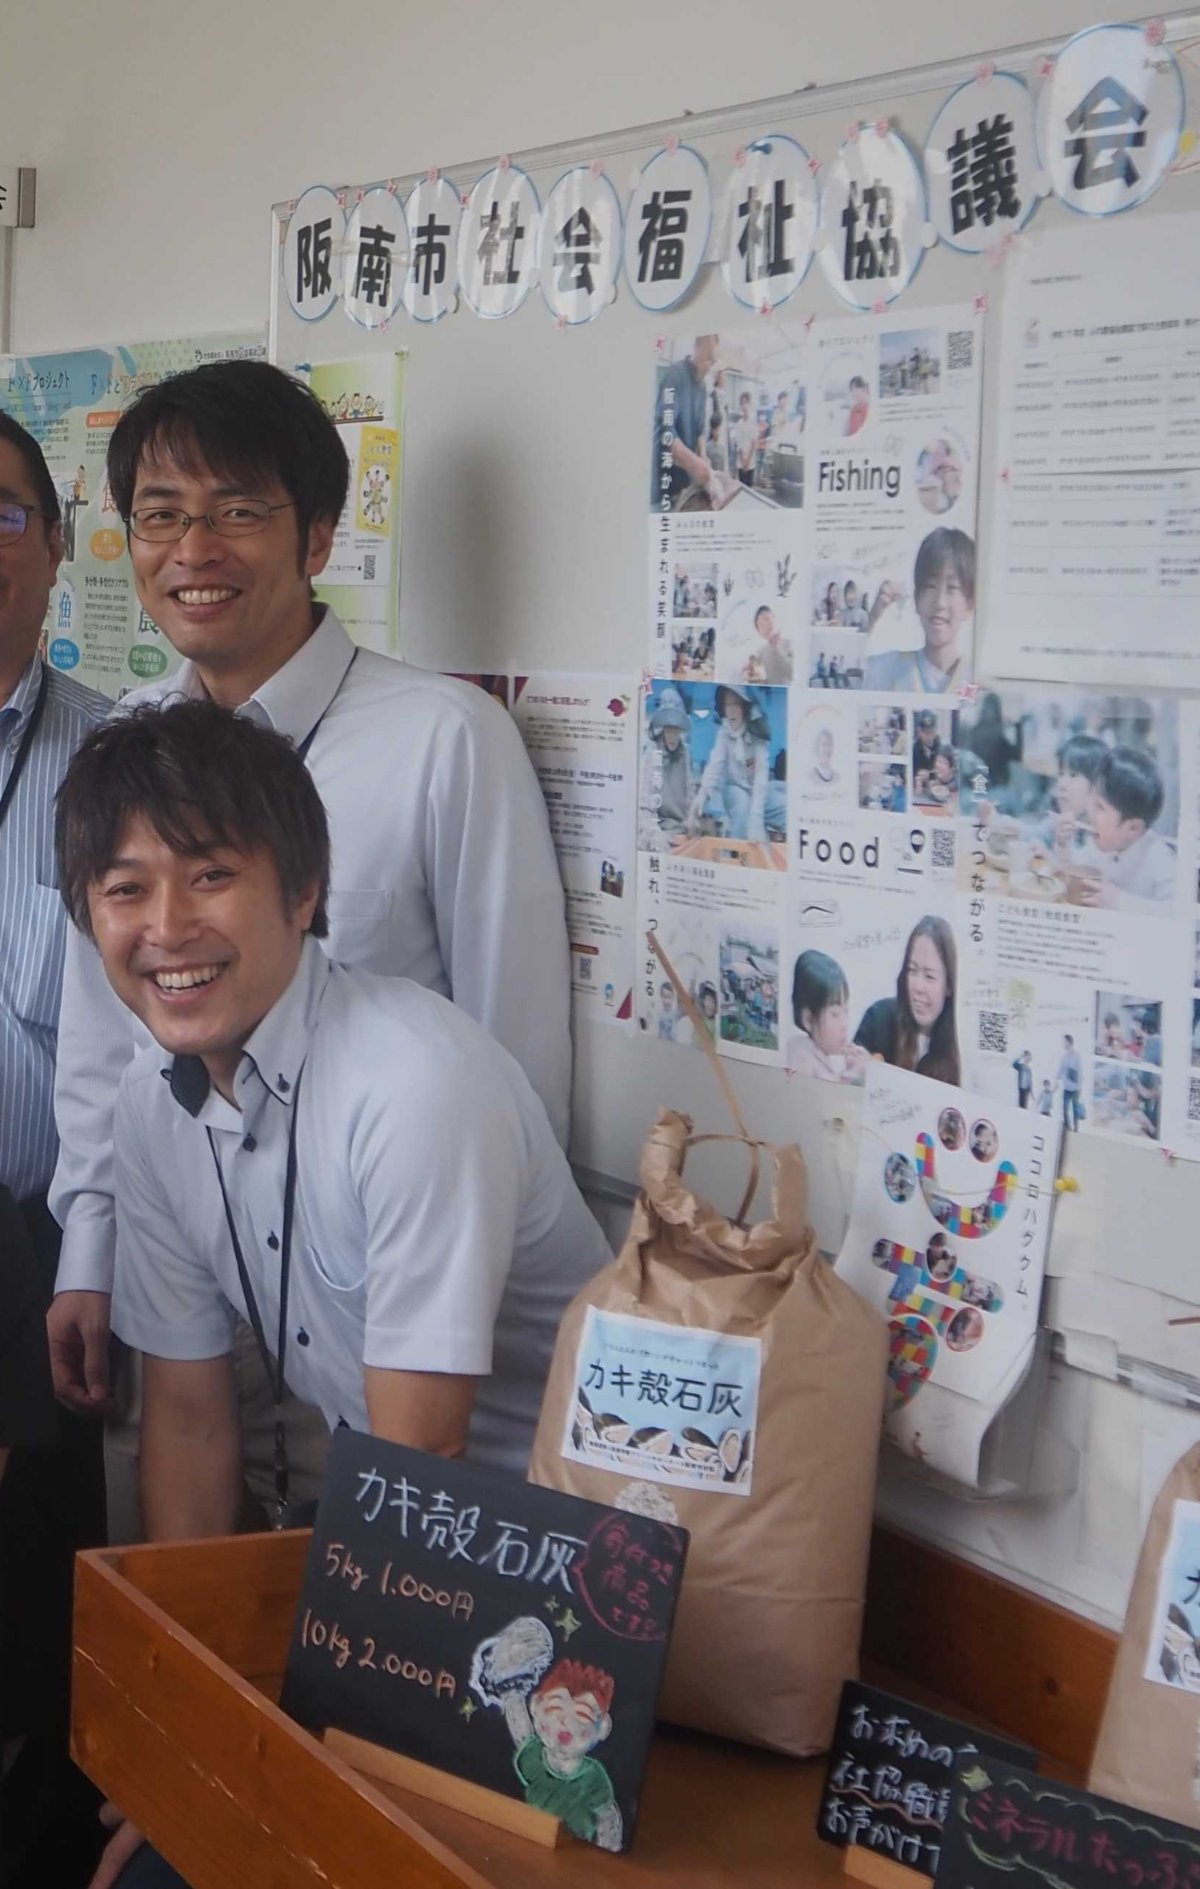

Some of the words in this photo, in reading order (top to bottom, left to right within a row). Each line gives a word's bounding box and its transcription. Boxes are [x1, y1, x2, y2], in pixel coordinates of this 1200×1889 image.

[296, 76, 1150, 307] 阪南市社会福祉協議会
[817, 458, 901, 498] Fishing
[799, 829, 879, 869] Food
[585, 1358, 743, 1418] カキ殻石灰
[355, 1466, 589, 1594] カキ殻石灰
[324, 1542, 369, 1592] 5kg
[300, 1607, 353, 1669] 10kg
[850, 1703, 979, 1768] お求めの
